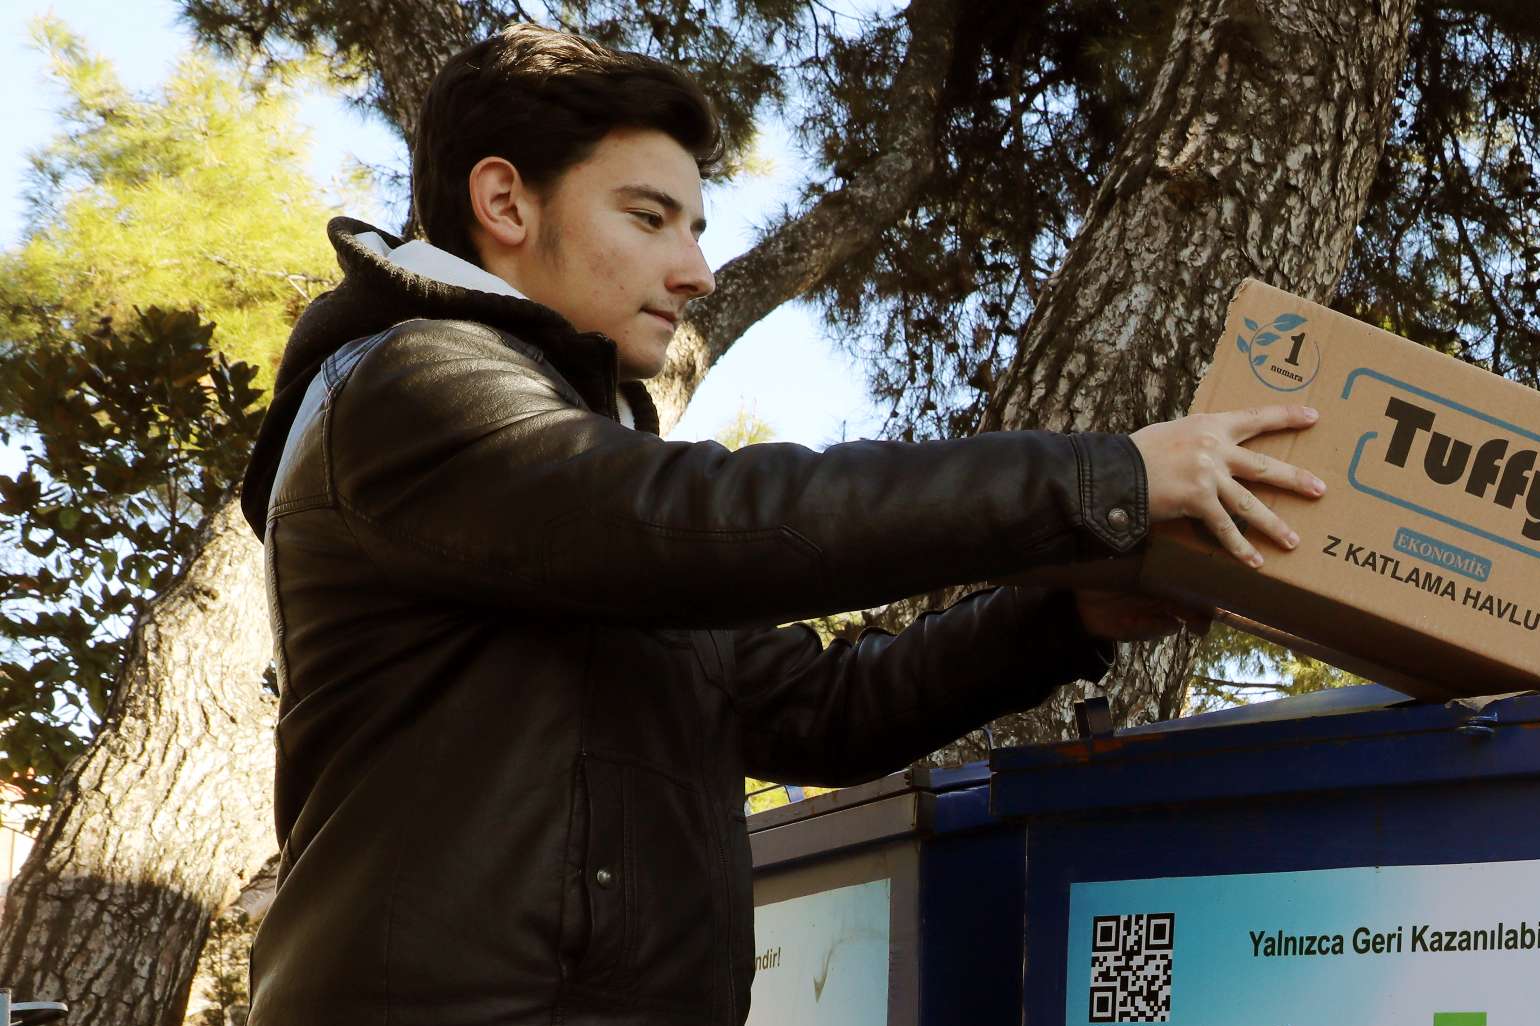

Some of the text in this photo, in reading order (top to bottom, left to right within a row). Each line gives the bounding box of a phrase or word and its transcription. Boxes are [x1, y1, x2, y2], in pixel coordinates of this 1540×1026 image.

[1284, 332, 1306, 367] 1
[1270, 364, 1303, 383] numara
[1322, 535, 1342, 557] Z
[1344, 543, 1457, 602] KATLAMA
[1398, 534, 1488, 579] EKONOMİK
[1249, 929, 1345, 957] Yalnızca
[1352, 926, 1403, 955] Geri
[754, 946, 782, 971] ndir!
